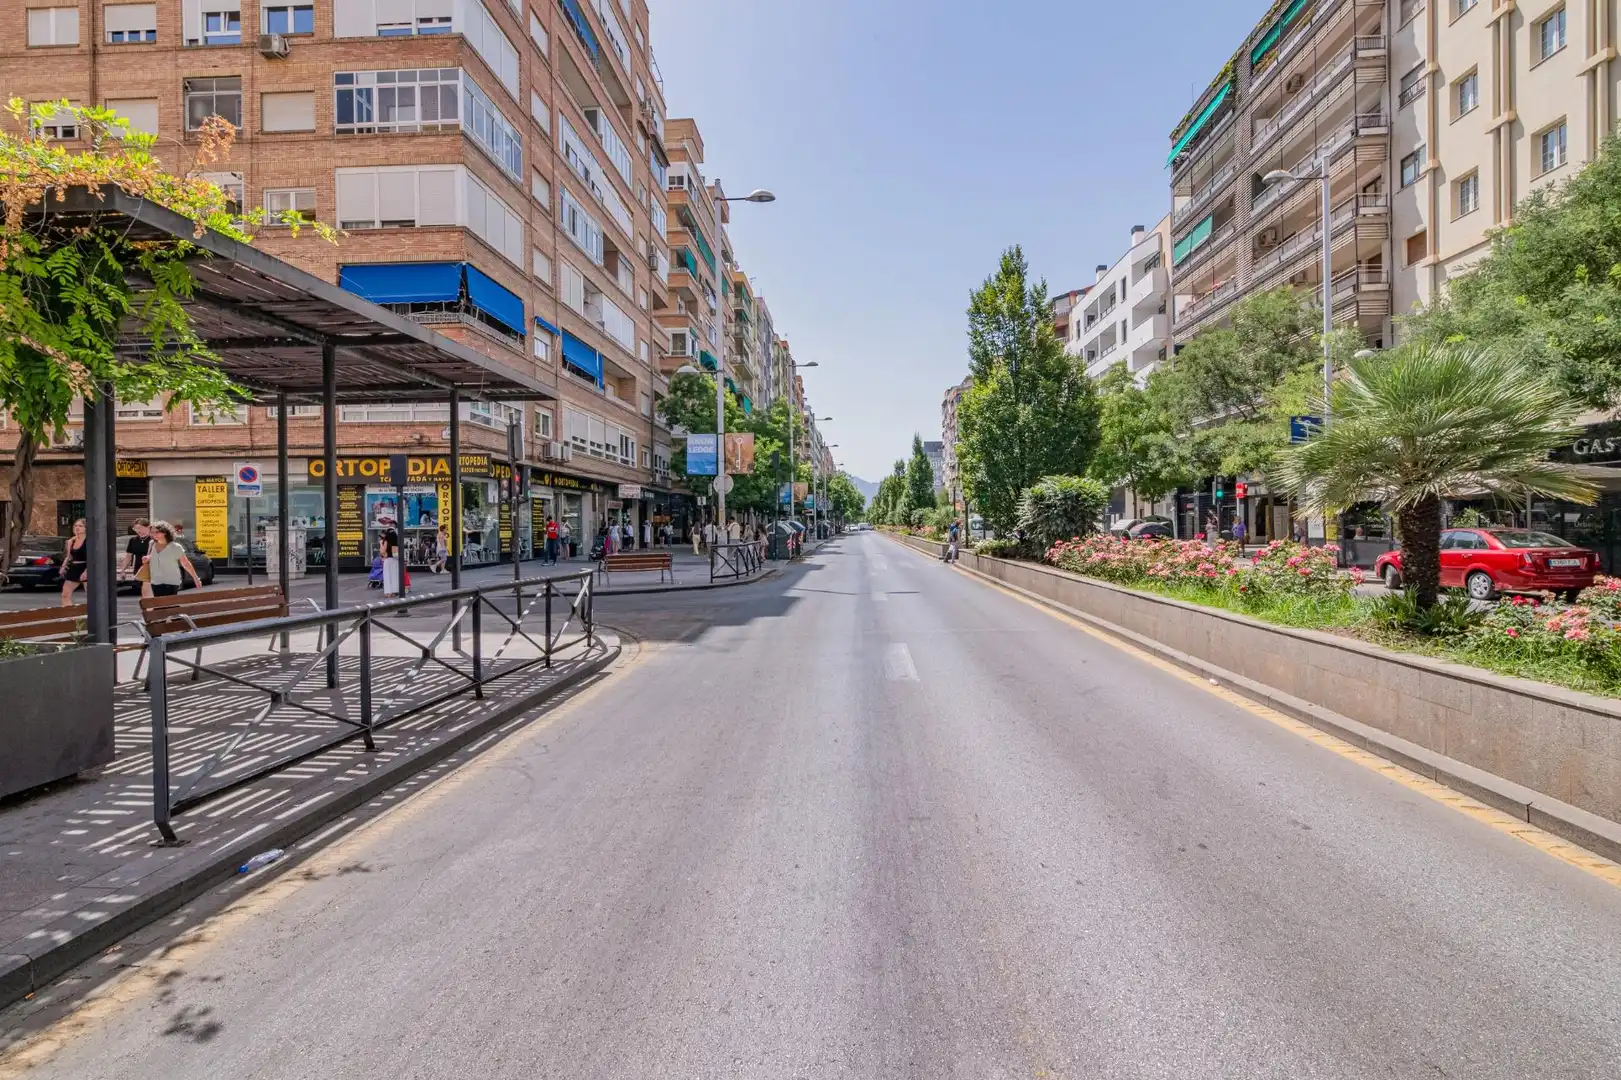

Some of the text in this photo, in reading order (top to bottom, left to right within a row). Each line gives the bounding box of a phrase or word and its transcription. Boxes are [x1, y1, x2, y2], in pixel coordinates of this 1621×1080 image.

[1572, 437, 1621, 455] GAS
[309, 458, 451, 477] ORTOPDIA
[458, 456, 488, 466] RTOPEDIA
[197, 485, 225, 493] TALLER
